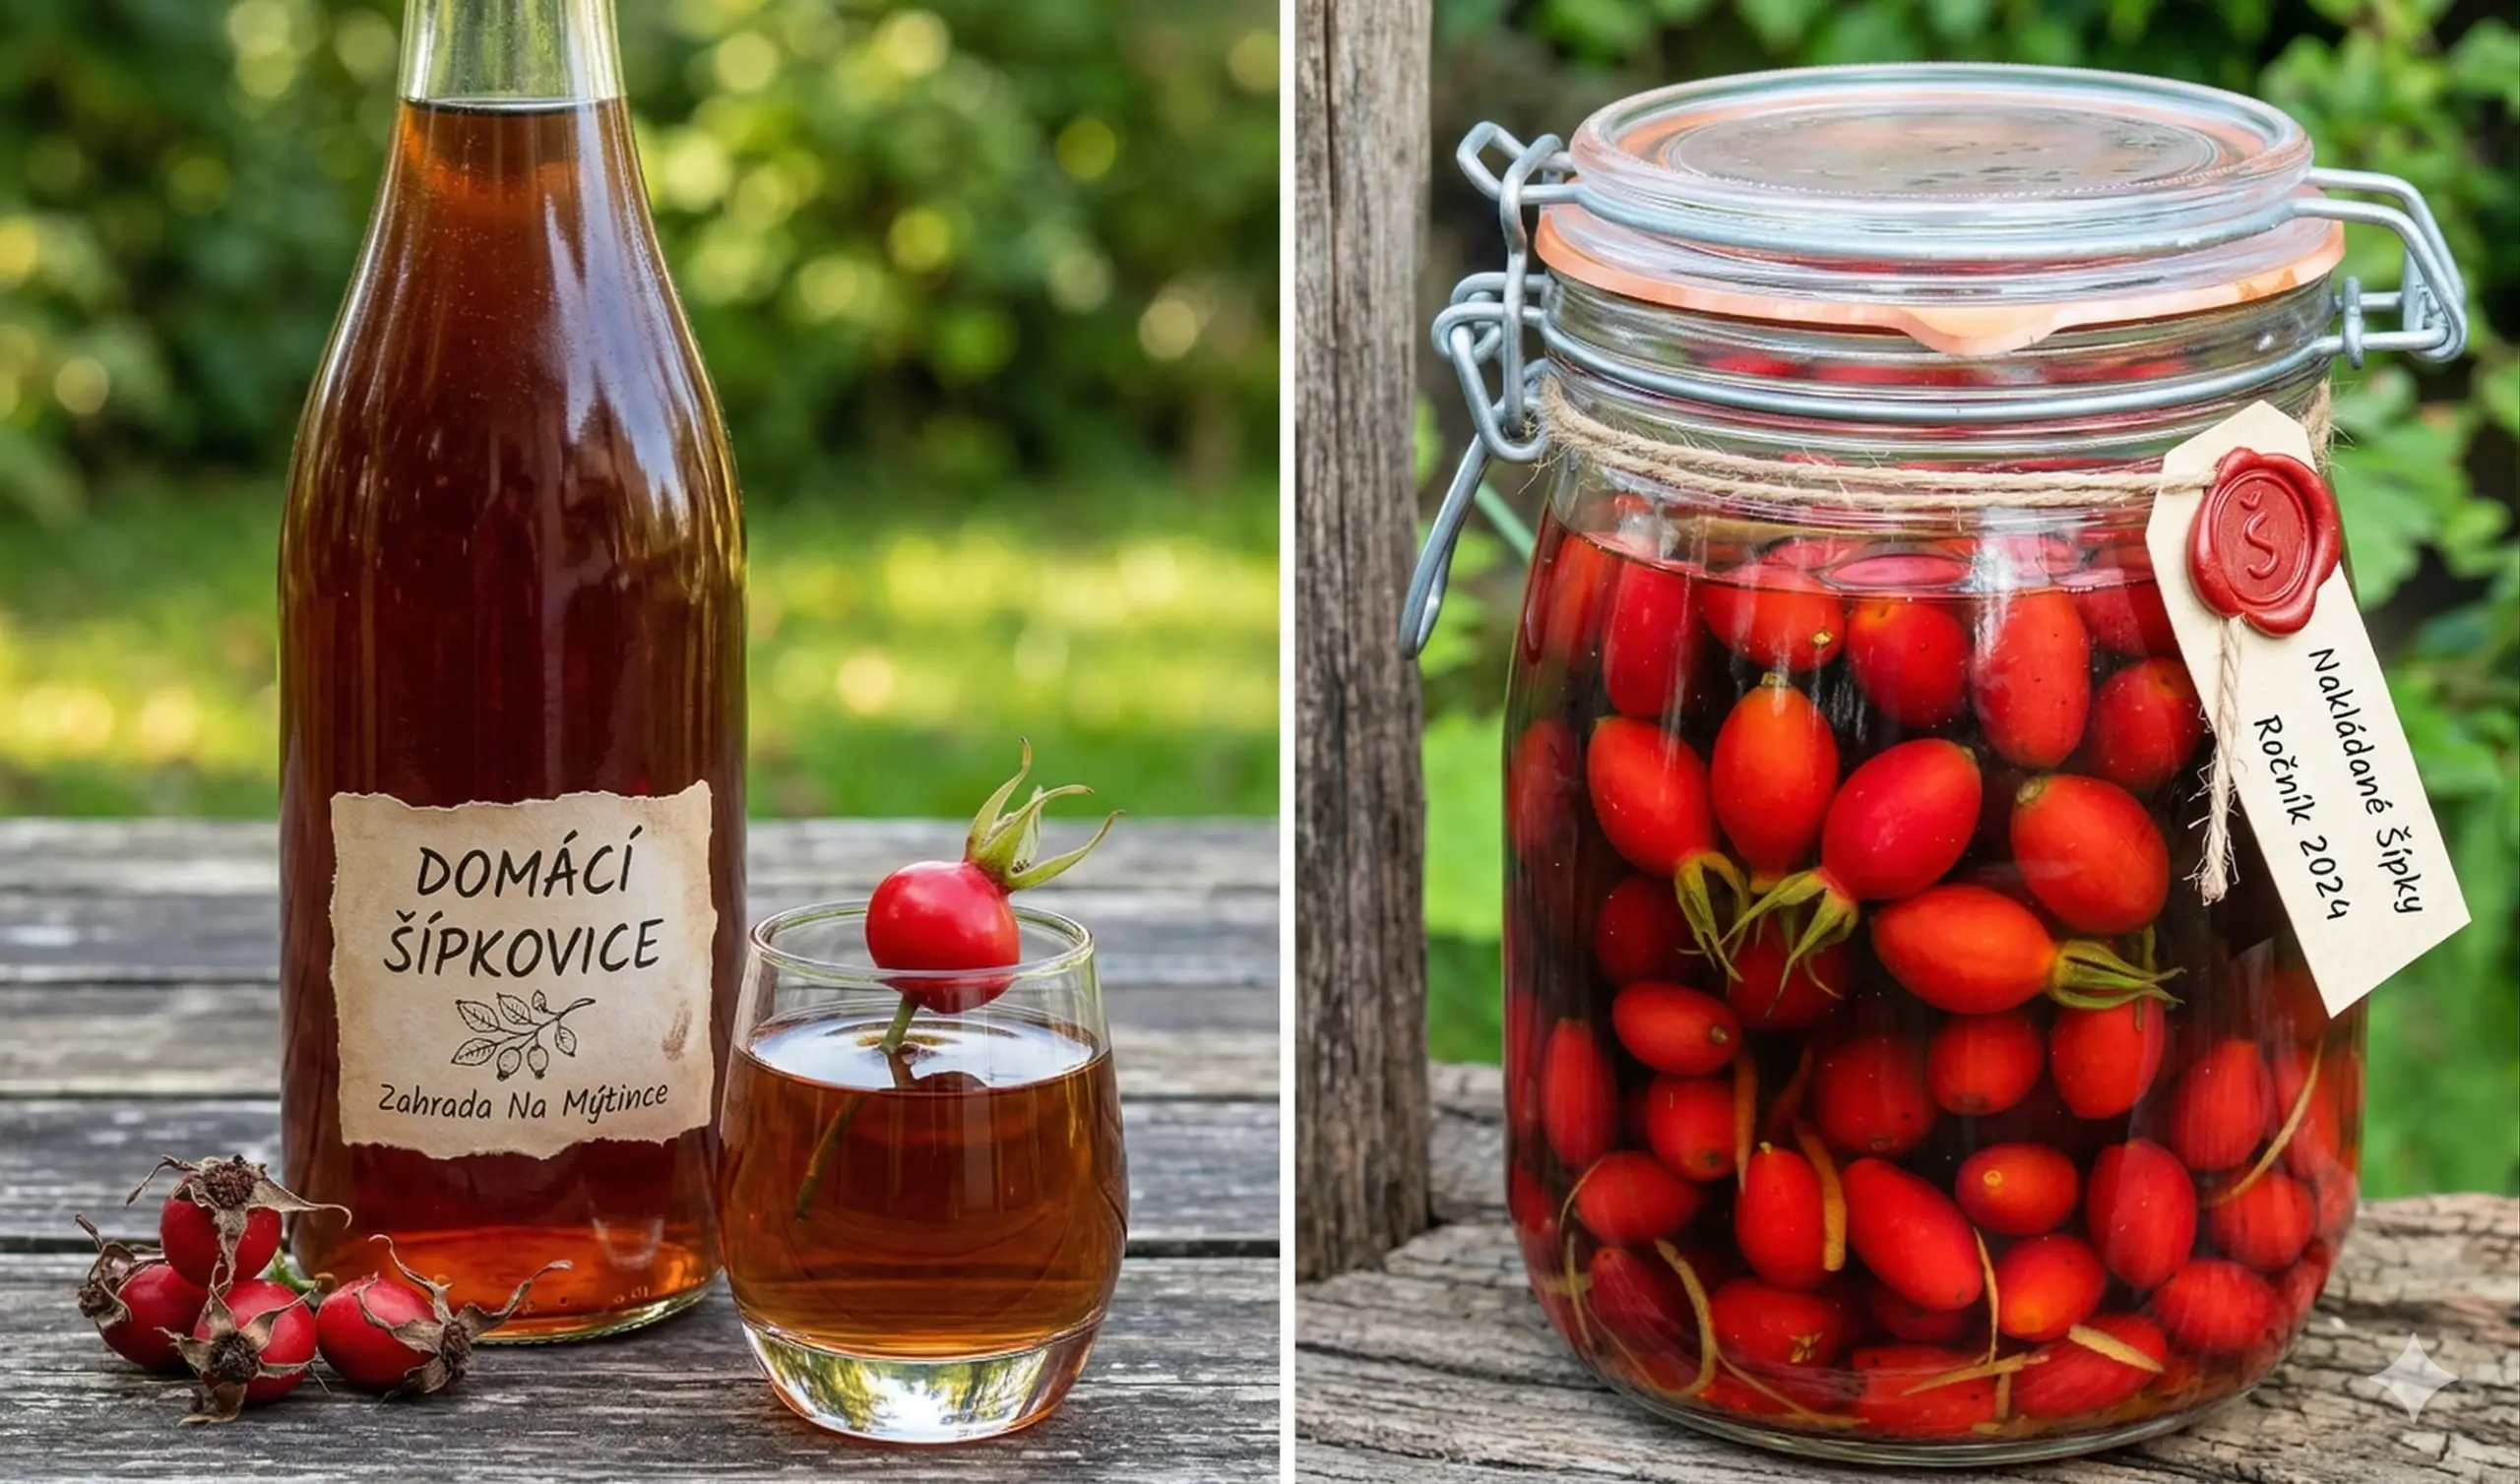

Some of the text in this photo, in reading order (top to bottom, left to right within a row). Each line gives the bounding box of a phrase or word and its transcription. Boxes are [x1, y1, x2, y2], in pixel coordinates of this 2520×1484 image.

[2239, 490, 2280, 580] Š
[2253, 714, 2351, 920] Ročník 2024
[2308, 648, 2424, 914] Nakládané Šípky
[416, 825, 643, 898] DOMÁCÍ
[383, 909, 664, 978] ŠÍPKOVICE
[378, 1082, 668, 1125] Zahrada Na Mýtince
